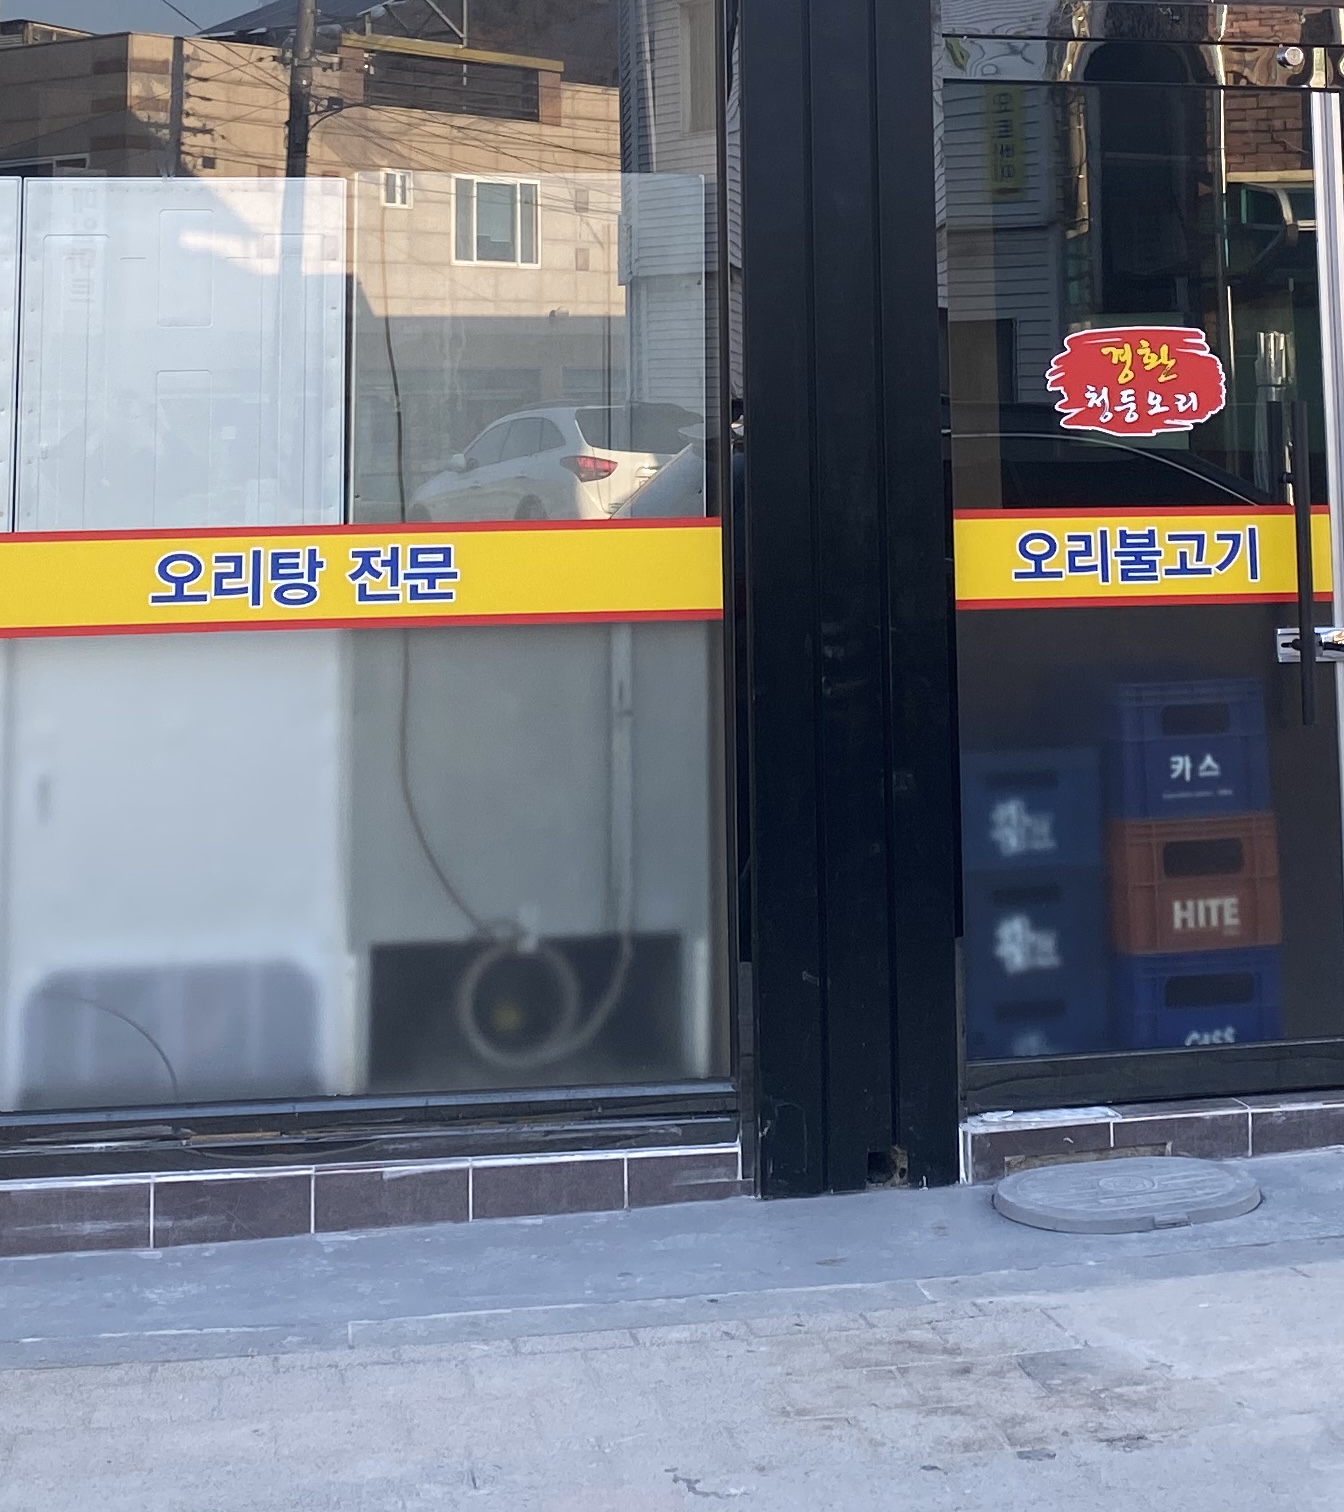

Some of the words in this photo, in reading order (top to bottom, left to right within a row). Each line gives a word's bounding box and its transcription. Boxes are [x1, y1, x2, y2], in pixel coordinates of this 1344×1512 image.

[148, 544, 326, 608] 오리탕
[347, 544, 461, 604] 전문
[1012, 525, 1260, 584] 오리불고기
[1172, 896, 1240, 931] HITE
